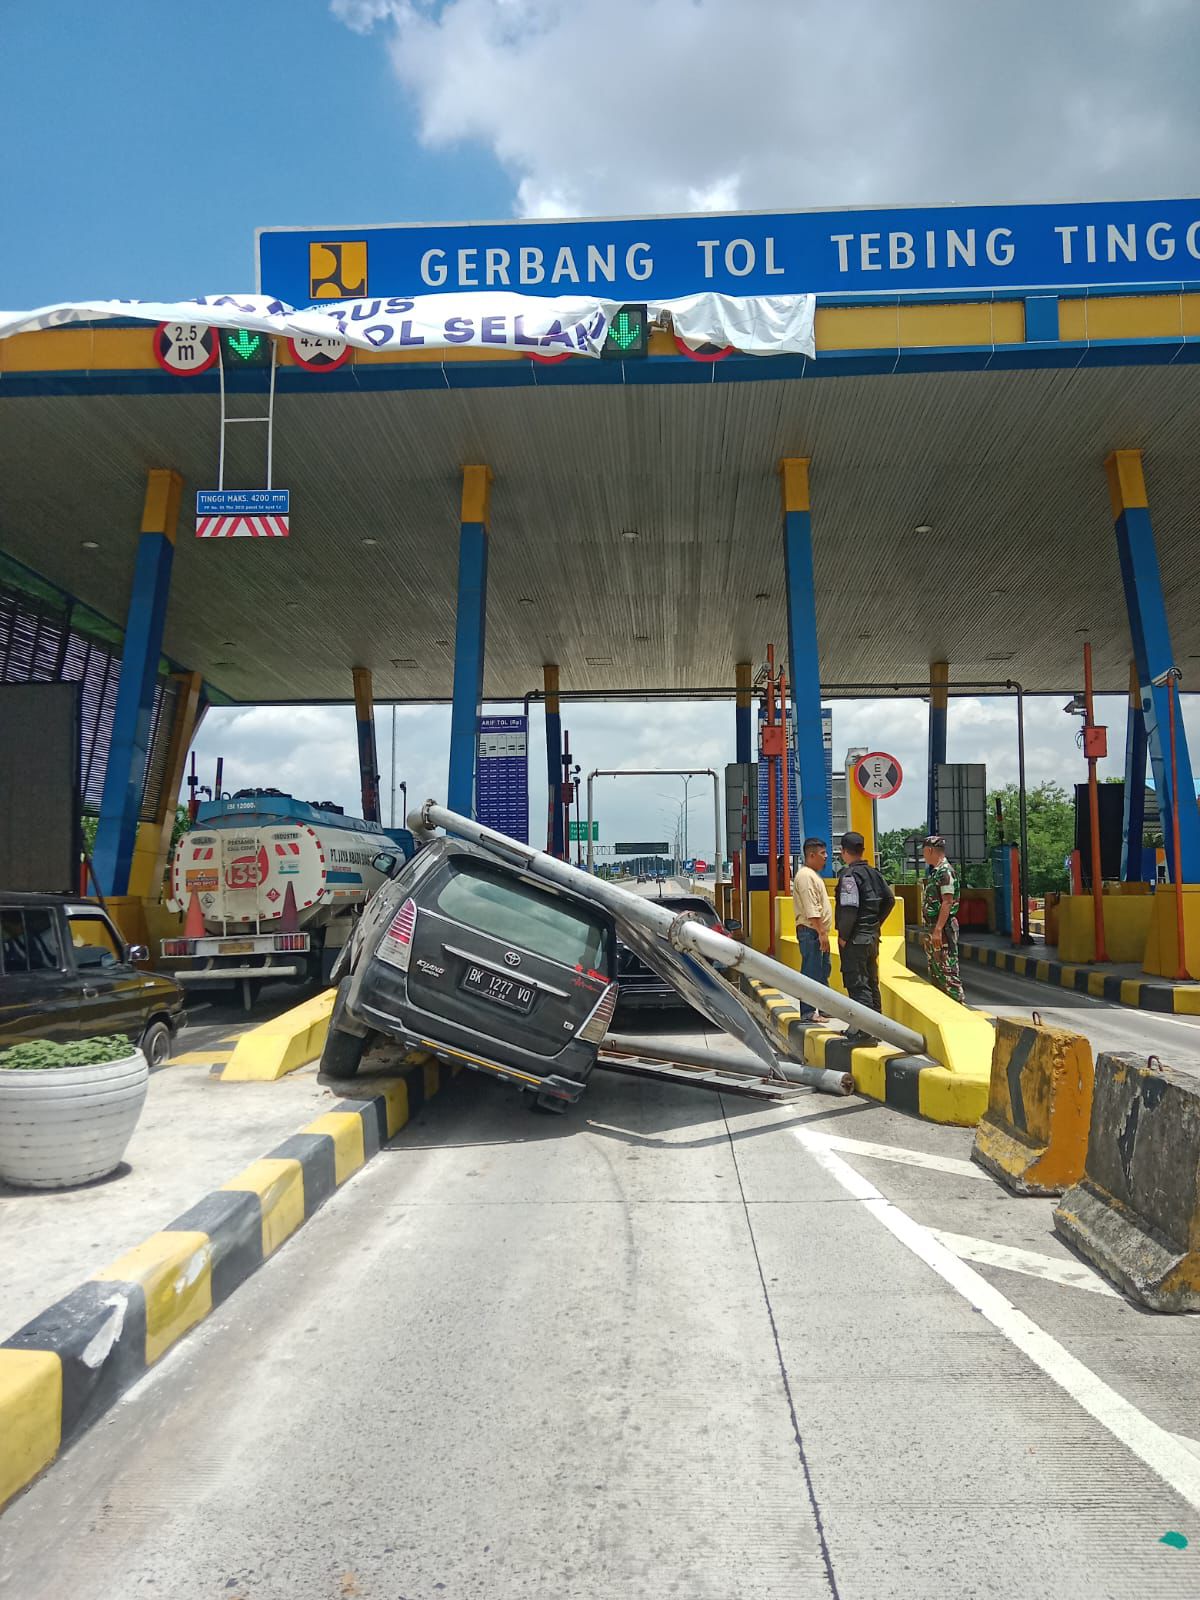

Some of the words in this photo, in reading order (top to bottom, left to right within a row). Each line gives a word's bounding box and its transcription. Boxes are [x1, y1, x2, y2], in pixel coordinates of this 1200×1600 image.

[420, 242, 654, 287] GERBANG
[696, 237, 785, 278] TOL
[830, 228, 1015, 272] TEBING
[175, 325, 197, 342] 2.5
[178, 344, 195, 361] m
[201, 495, 225, 503] TINGGI
[251, 494, 270, 502] 4200
[224, 863, 262, 886] 135
[469, 968, 484, 984] BK
[489, 976, 514, 995] 1277
